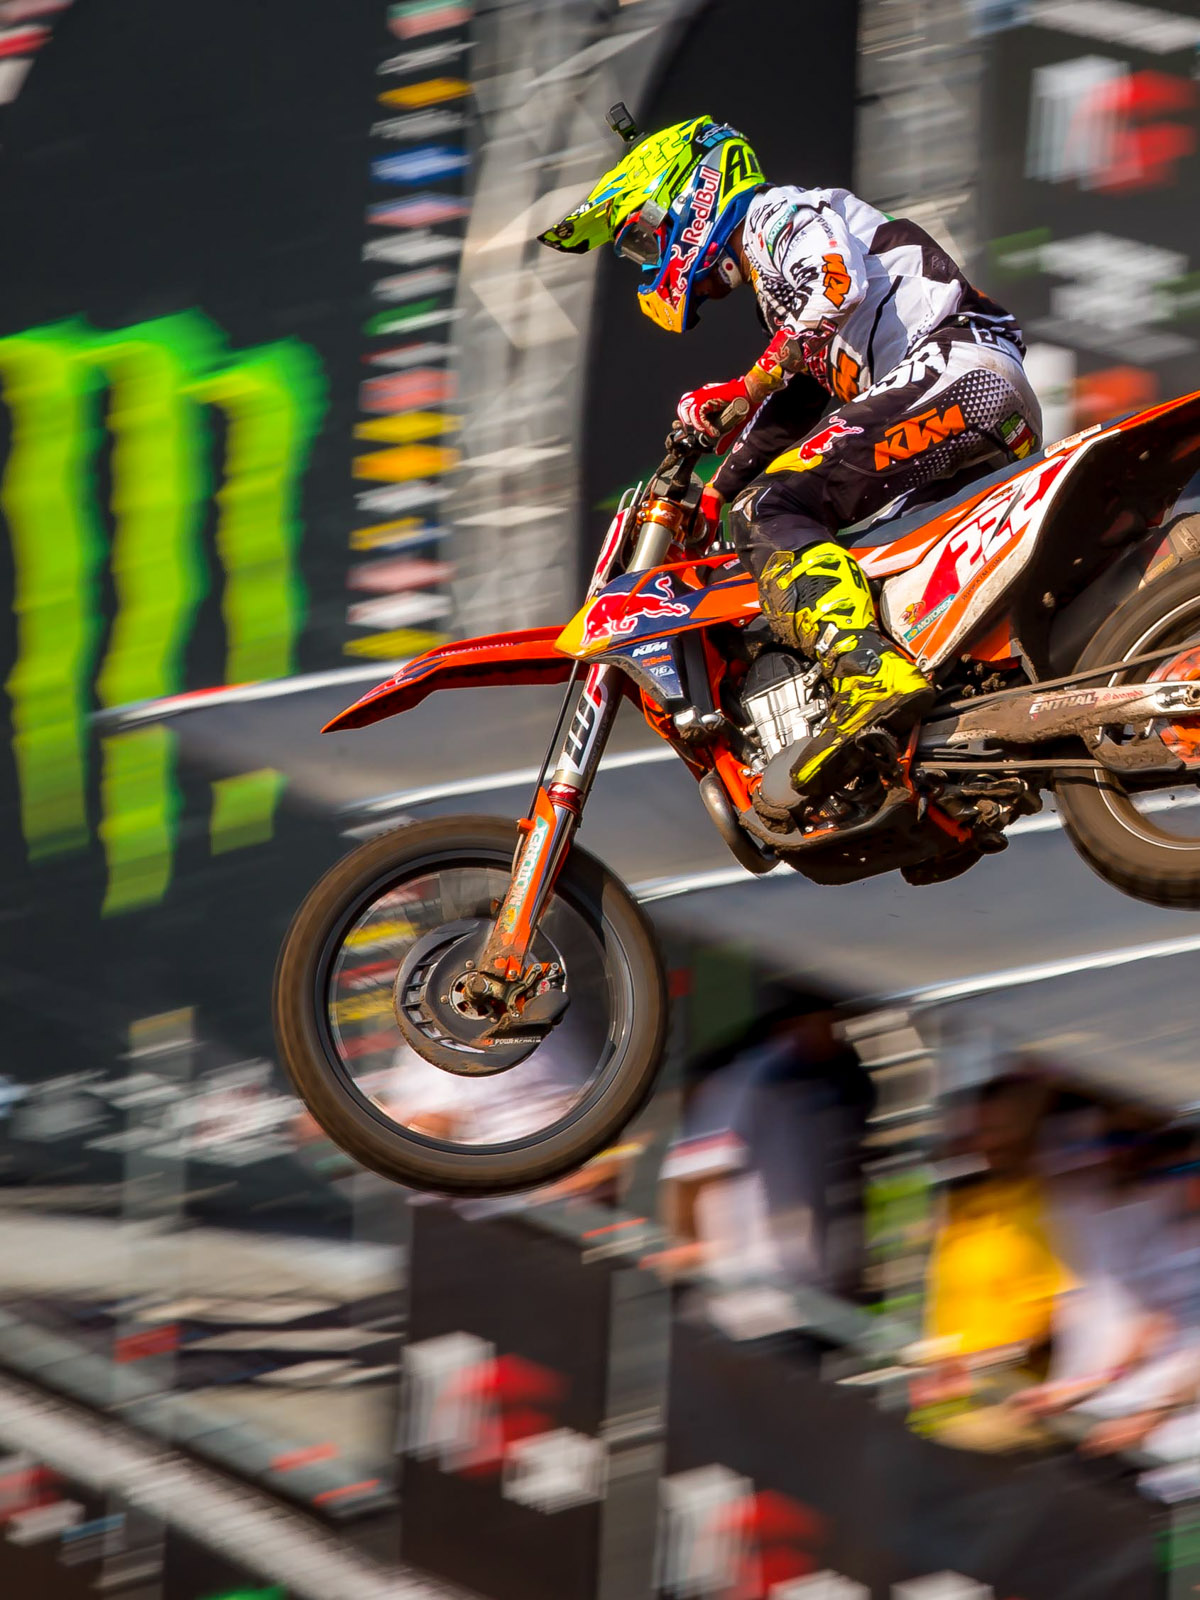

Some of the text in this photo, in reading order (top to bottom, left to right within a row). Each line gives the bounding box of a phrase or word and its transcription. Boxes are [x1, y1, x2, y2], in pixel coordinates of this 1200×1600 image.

[822, 253, 852, 310] KTM
[874, 403, 967, 471] KTM
[917, 595, 954, 632] MOTOREX
[632, 641, 668, 657] KTM
[1029, 692, 1096, 714] ENTHAL
[509, 823, 547, 906] MOTOREX
